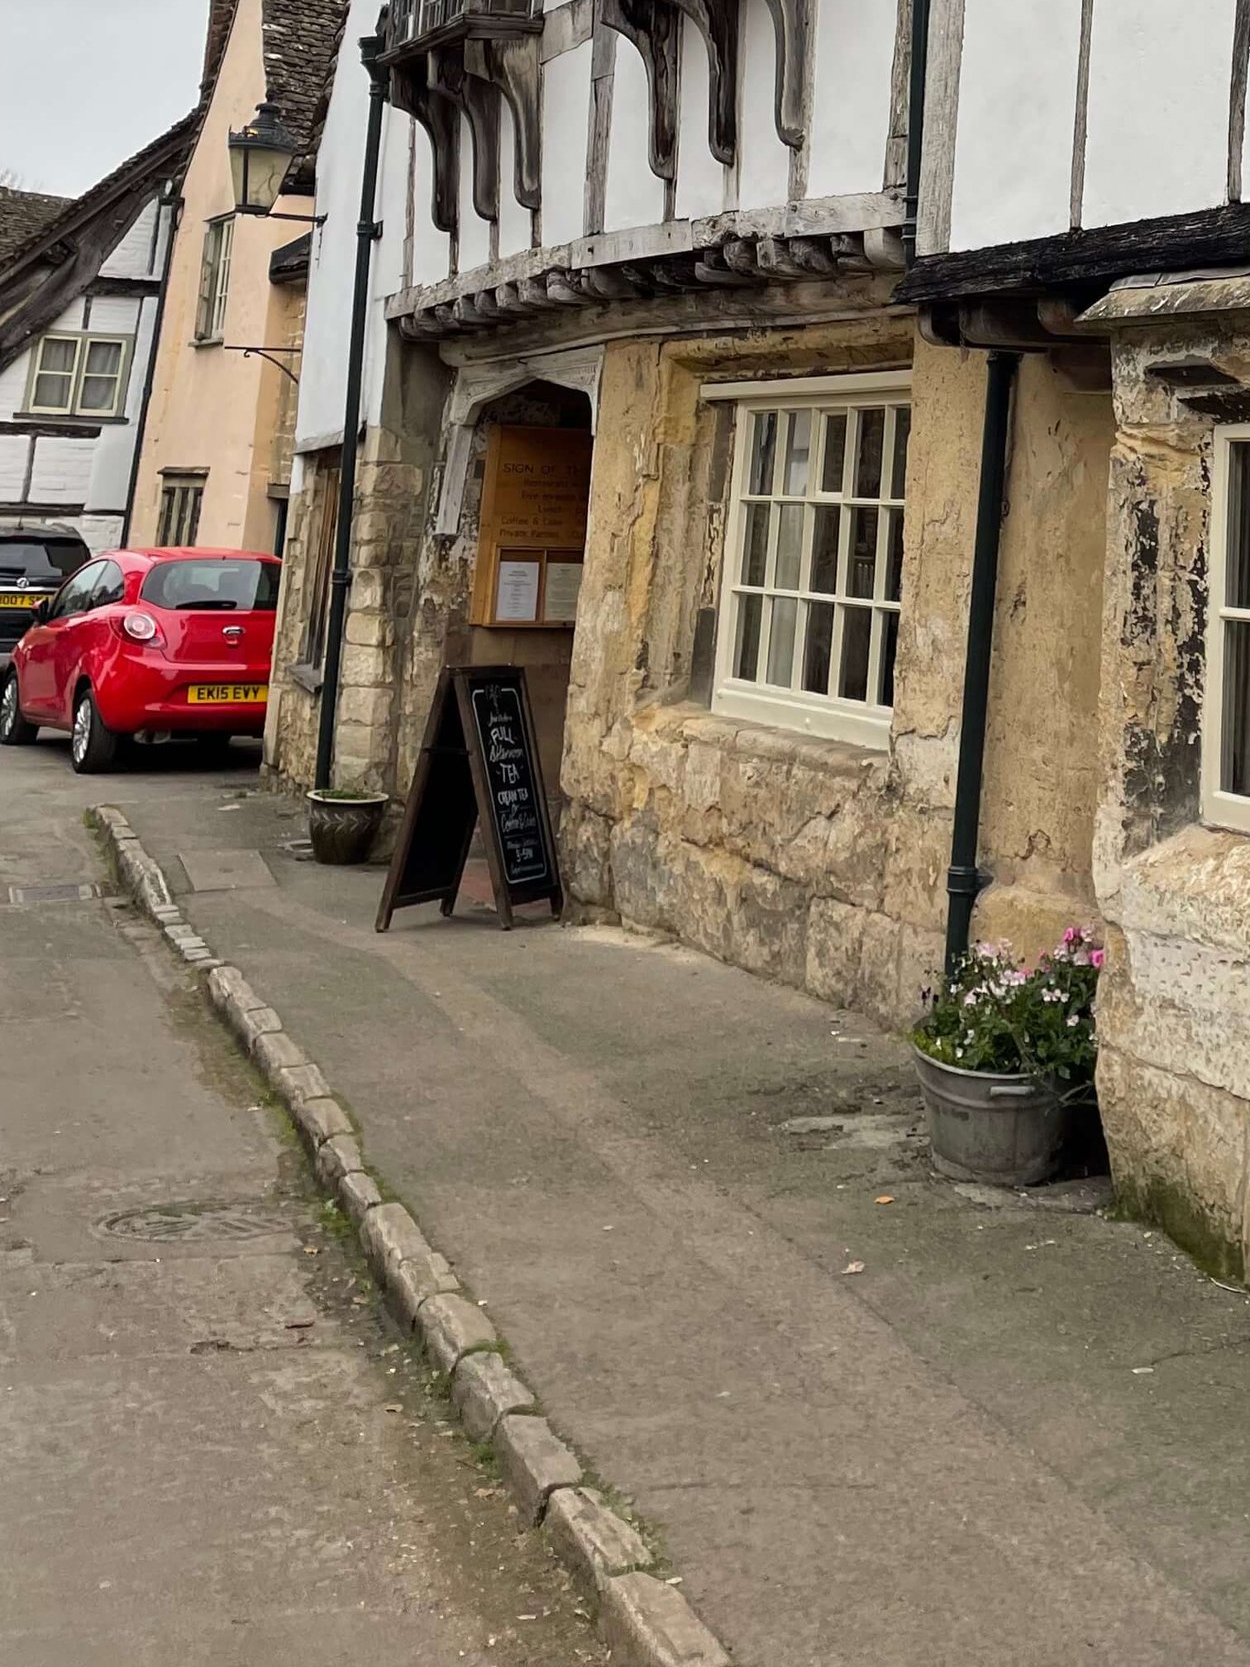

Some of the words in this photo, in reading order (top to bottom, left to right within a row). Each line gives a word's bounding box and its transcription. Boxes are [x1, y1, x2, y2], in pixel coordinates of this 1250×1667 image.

[503, 463, 534, 474] SIGN
[541, 465, 556, 475] OF
[501, 516, 528, 526] Coffee
[197, 687, 229, 700] EK15
[233, 687, 260, 700] EVY
[490, 726, 515, 745] FULL
[500, 763, 520, 784] TEA
[497, 790, 517, 806] CREAM
[517, 787, 529, 801] TEA
